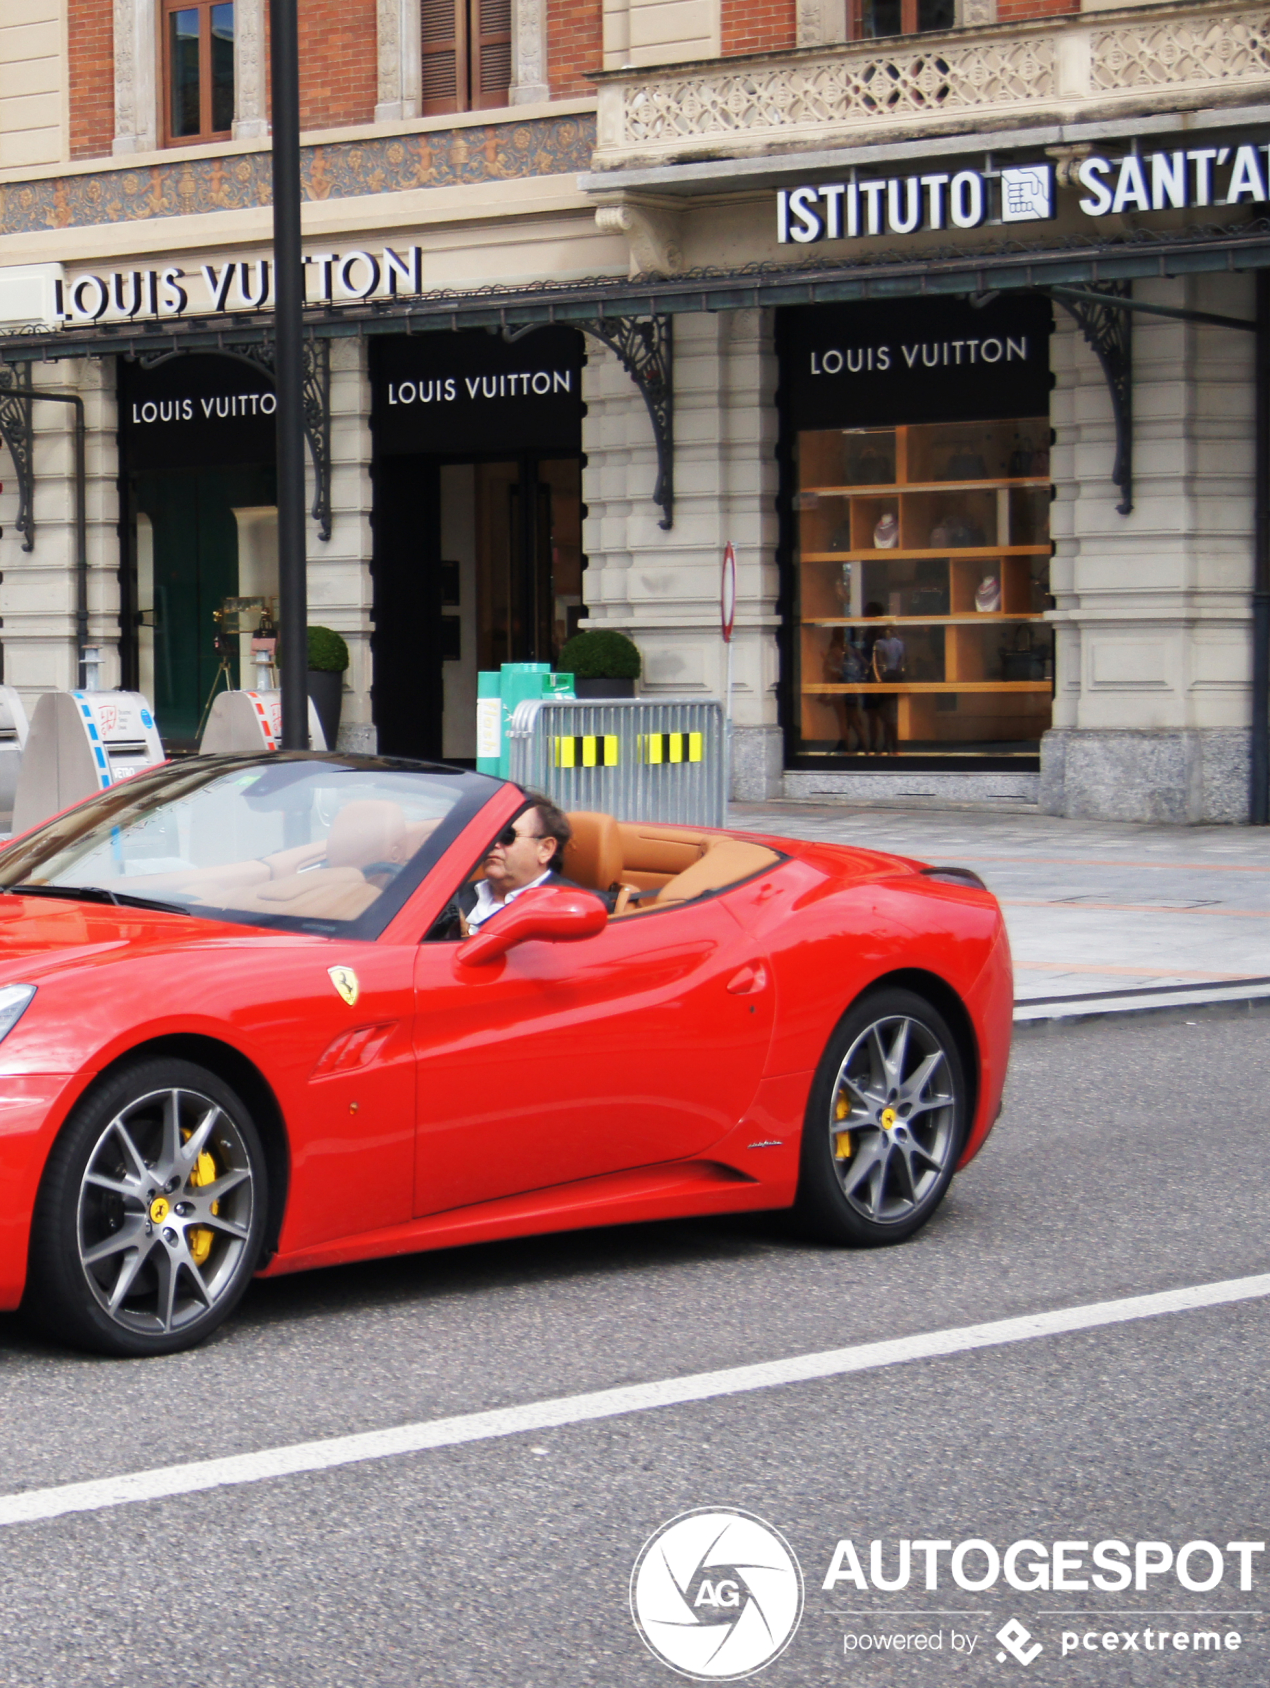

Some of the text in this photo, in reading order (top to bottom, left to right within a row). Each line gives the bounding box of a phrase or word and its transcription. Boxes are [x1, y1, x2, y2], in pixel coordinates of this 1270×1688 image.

[777, 144, 1270, 245] ISTITUTO SANT'A
[54, 246, 423, 321] LOUIS VUTON
[811, 336, 1027, 375] LOUIS VUITTON
[388, 371, 572, 405] LOUIS VUITTON
[132, 393, 277, 424] LOUIS VUITTO
